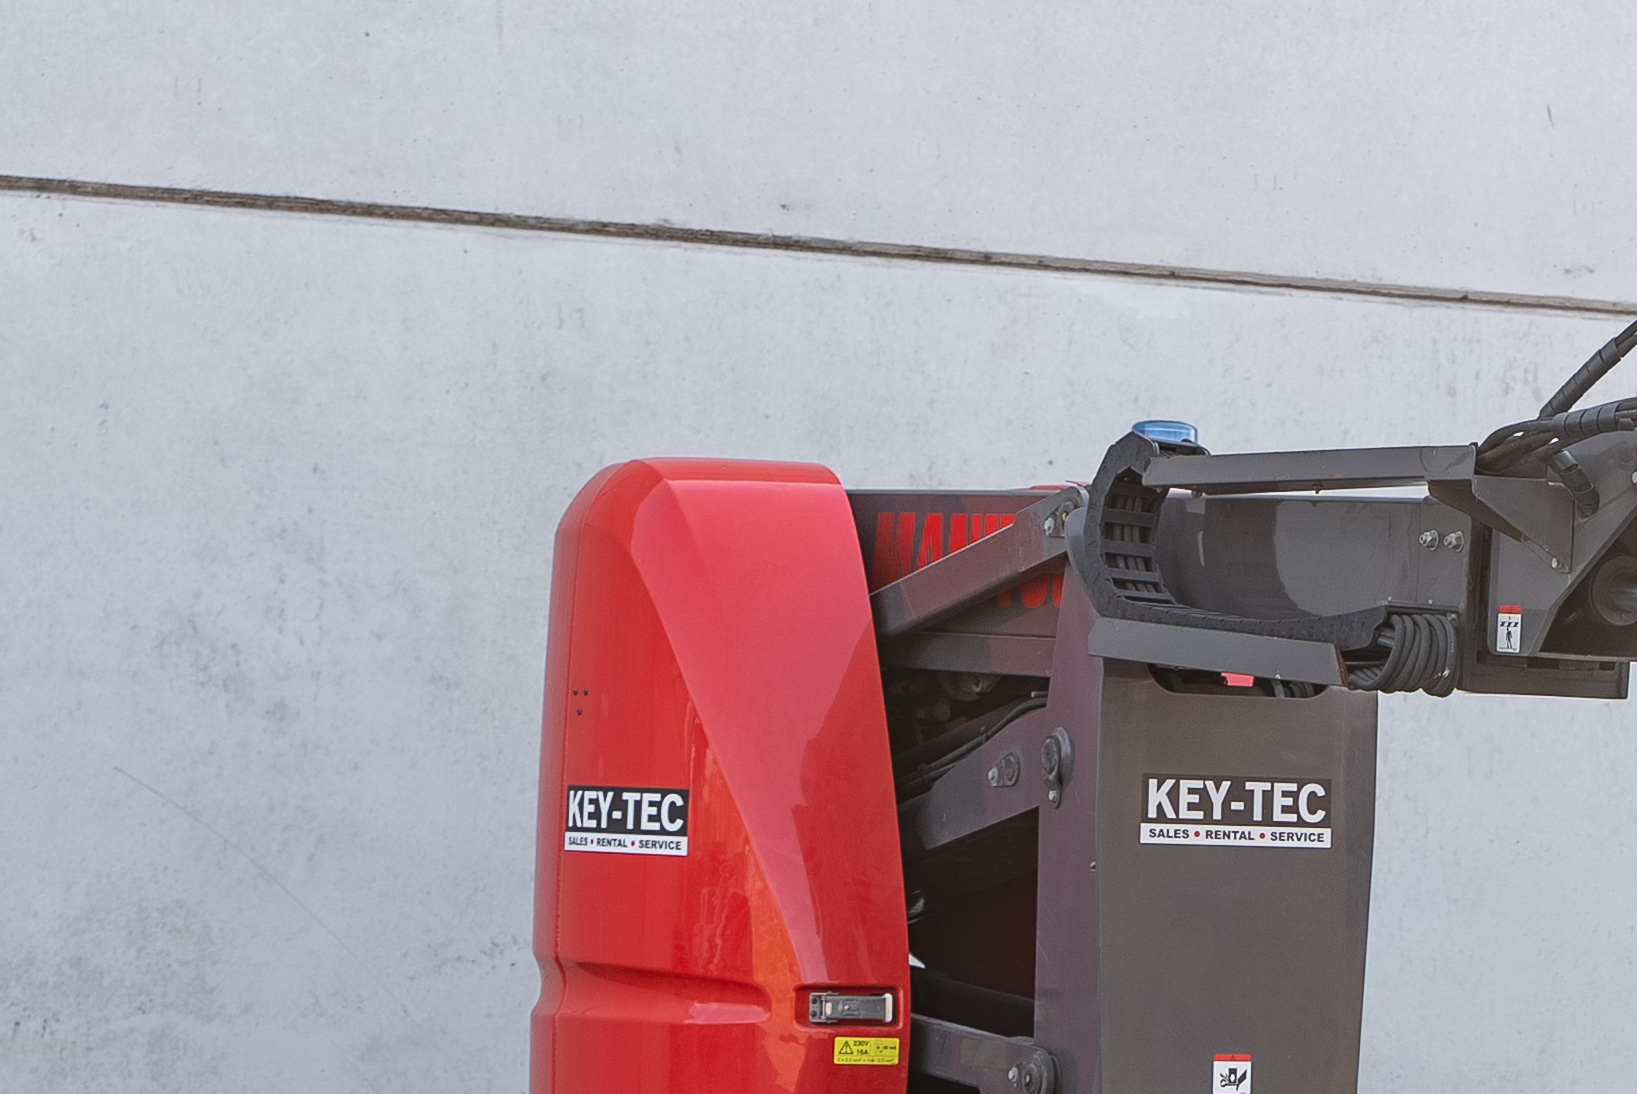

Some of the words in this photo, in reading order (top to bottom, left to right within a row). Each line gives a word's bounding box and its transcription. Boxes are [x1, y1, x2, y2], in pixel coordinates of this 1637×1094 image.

[567, 789, 684, 832] KEY-TEC
[1147, 778, 1326, 824] KEY-TEC
[568, 836, 588, 846] SALES
[596, 838, 628, 848] RENTAL
[638, 840, 682, 850] SERVICE
[1148, 828, 1190, 839] SALES
[1205, 829, 1255, 841] RENTAL
[1270, 831, 1325, 843] SERVICE
